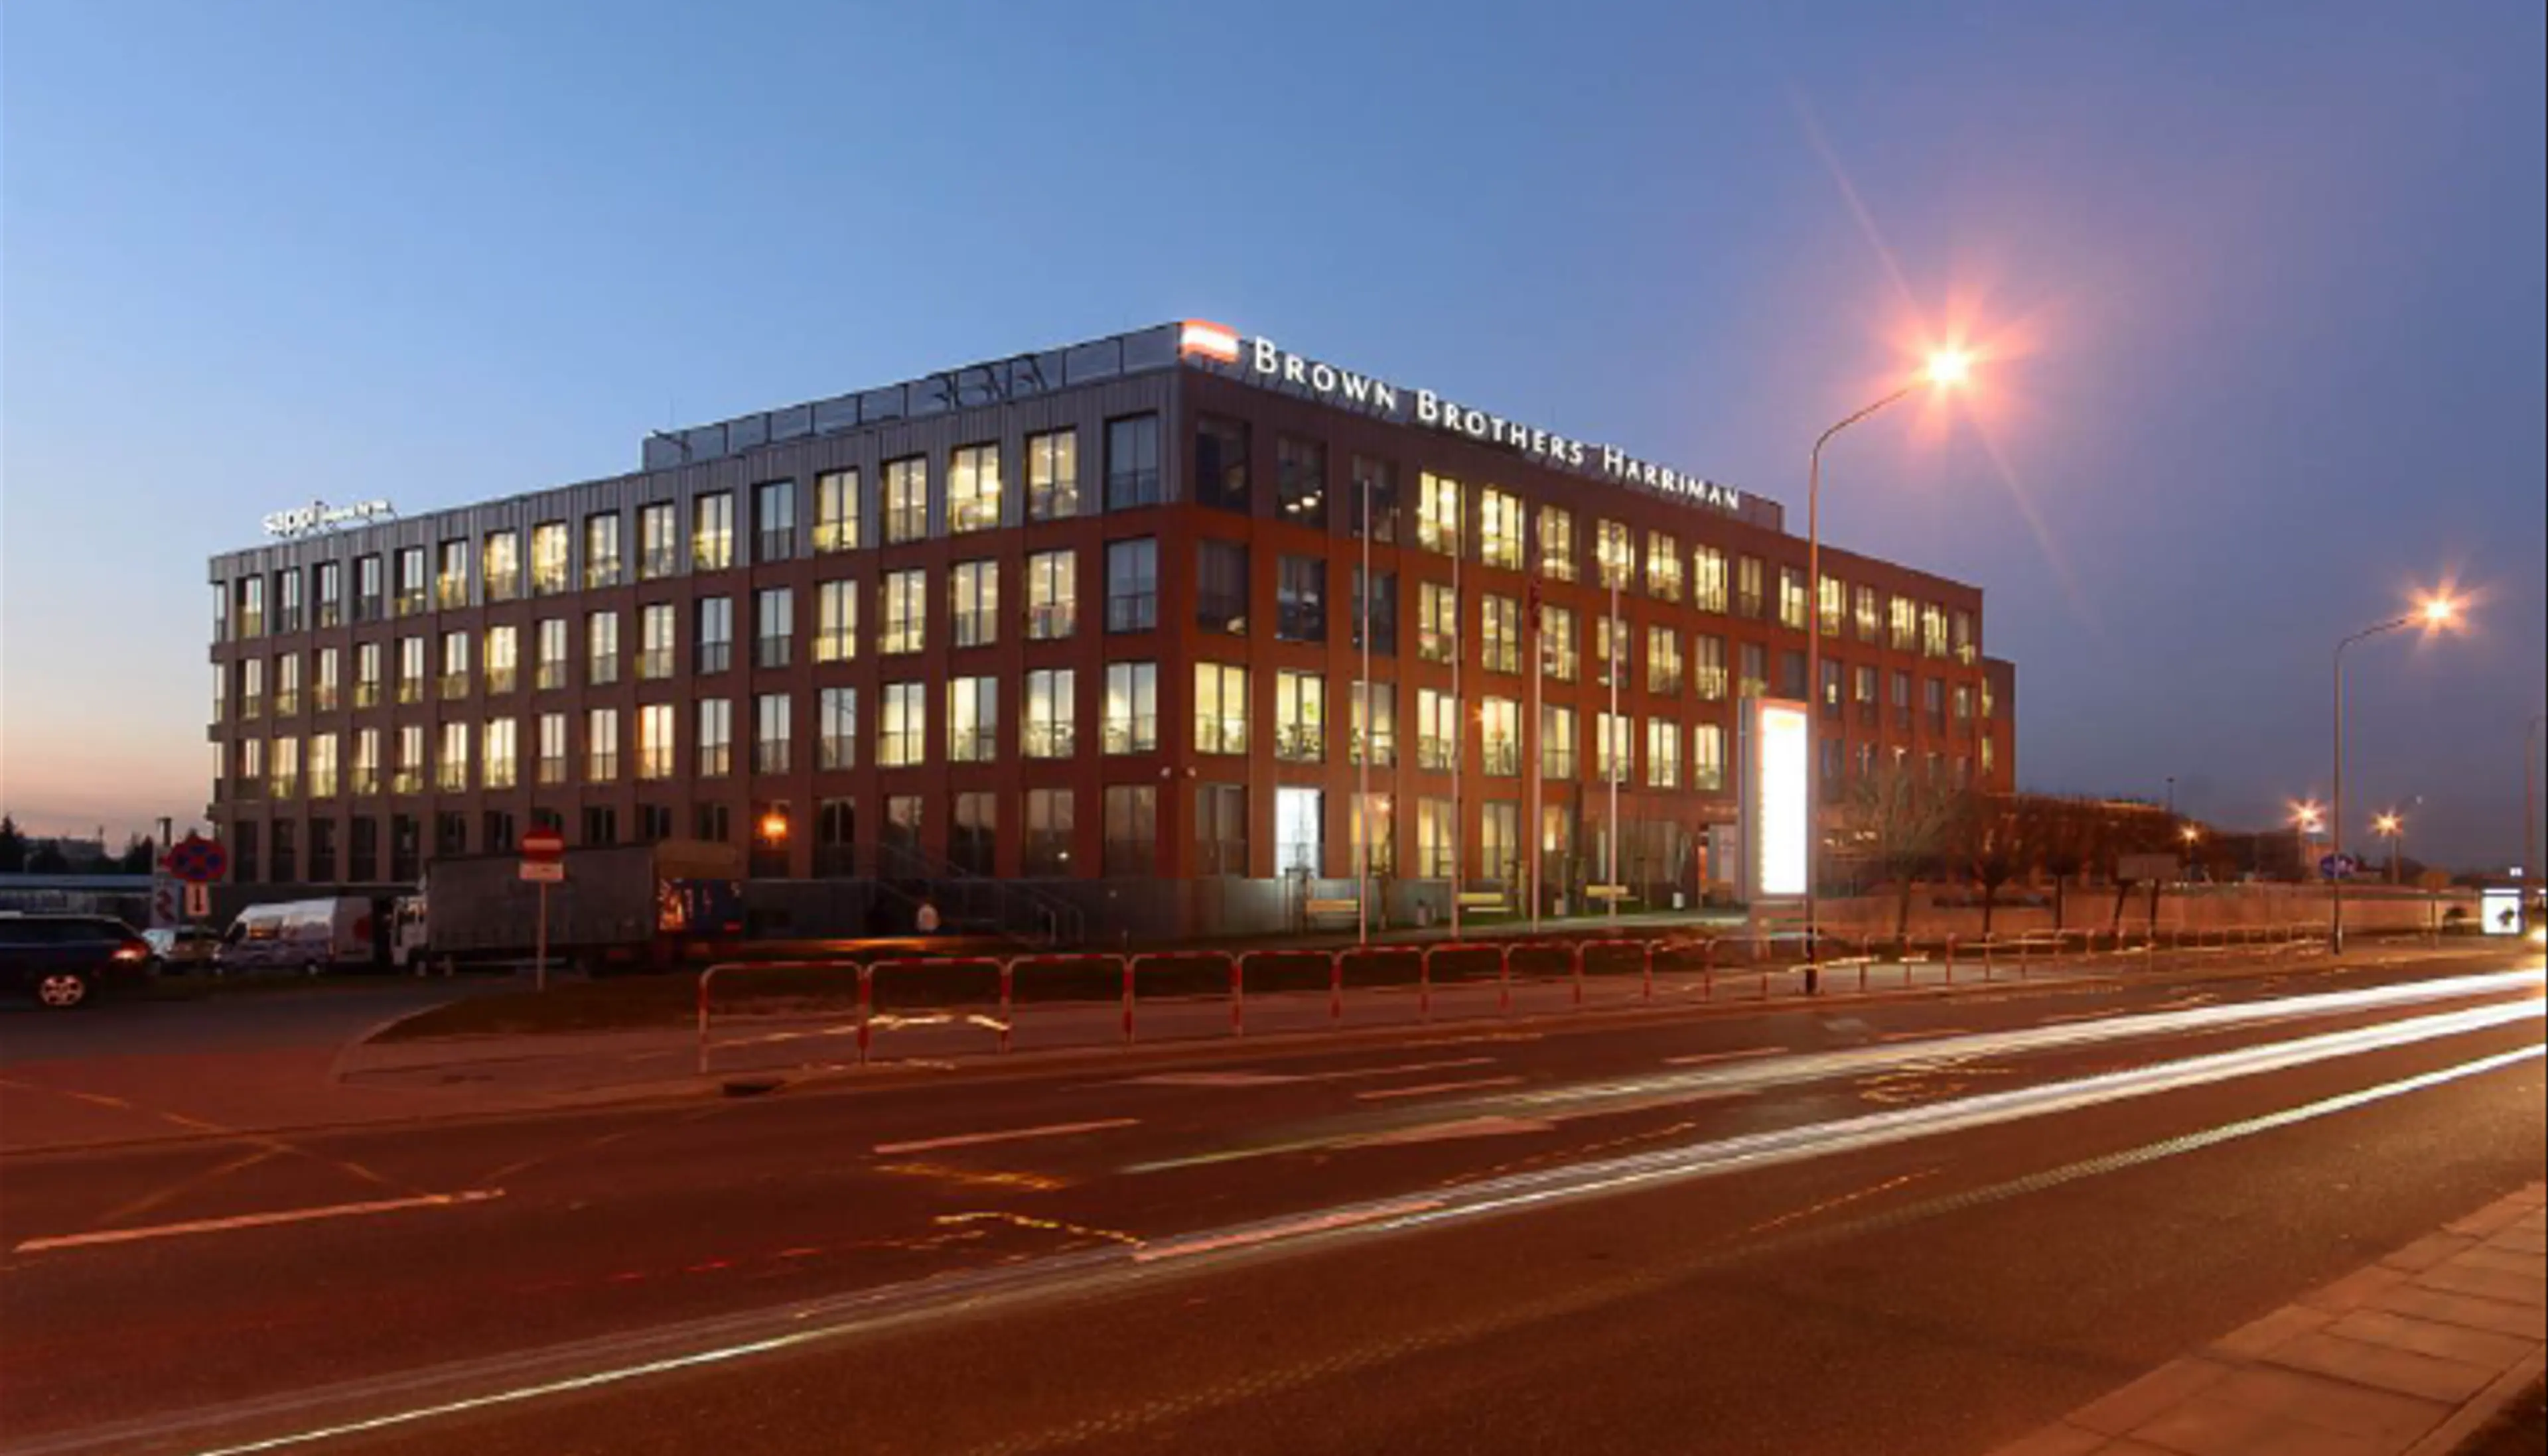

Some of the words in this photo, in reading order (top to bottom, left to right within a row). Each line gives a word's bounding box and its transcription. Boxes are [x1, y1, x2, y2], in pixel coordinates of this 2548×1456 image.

[1253, 336, 1396, 411] BROWN
[1417, 389, 1585, 466] BROTHERS
[1604, 444, 1740, 511] HARRIMAN
